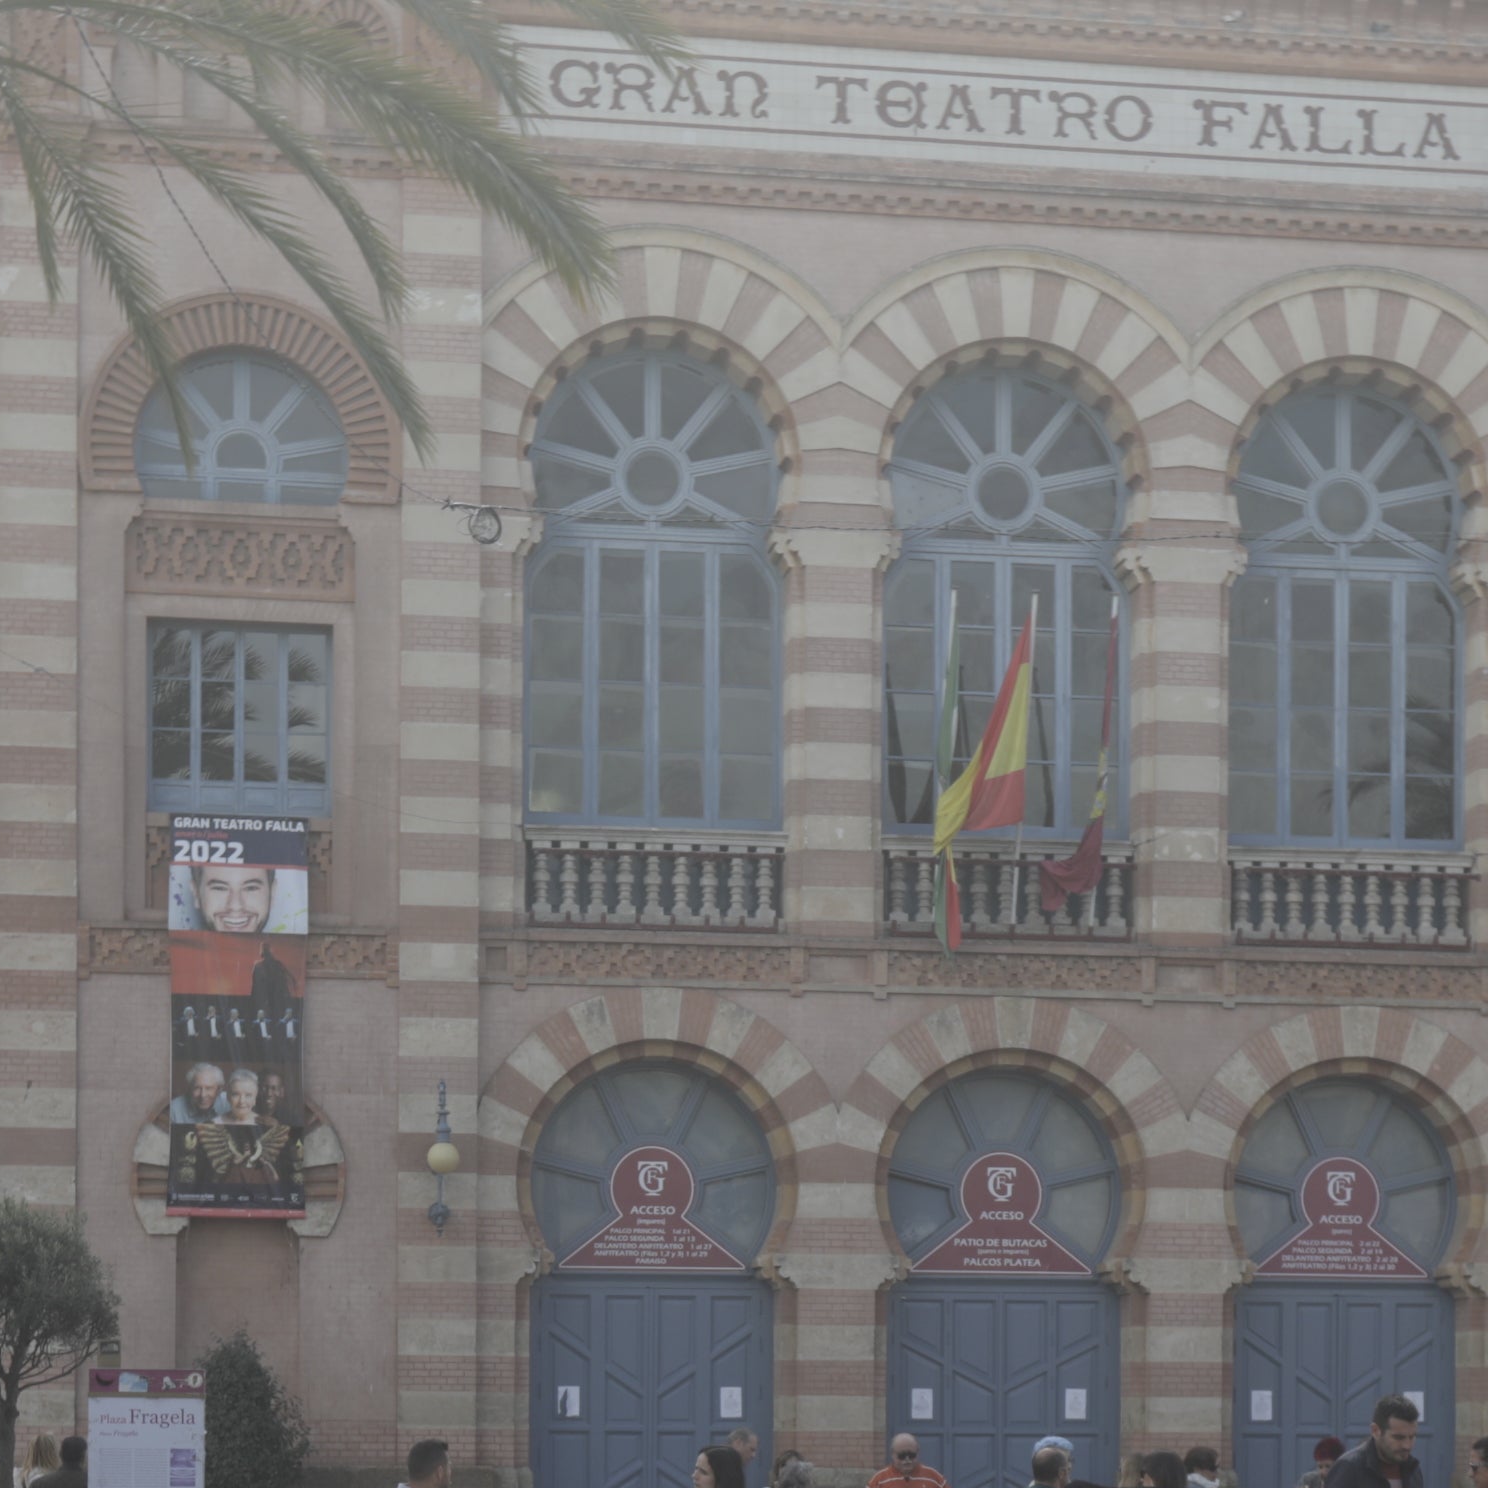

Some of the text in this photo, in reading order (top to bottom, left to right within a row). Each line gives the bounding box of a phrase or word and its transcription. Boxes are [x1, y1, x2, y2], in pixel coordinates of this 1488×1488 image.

[548, 58, 1461, 164] GRAN TEATRO FALLA
[174, 817, 304, 832] GRAN TEATRO FALLA
[174, 840, 244, 864] 2022
[630, 1205, 676, 1215] ACCESO
[980, 1211, 1024, 1220] ACCESO
[1319, 1215, 1363, 1224] ACCESO
[954, 1238, 1048, 1248] PATIO DE BUTACAS
[963, 1258, 1041, 1267] PALCOS PLATEA
[99, 1408, 196, 1429] Plaza Fragela
